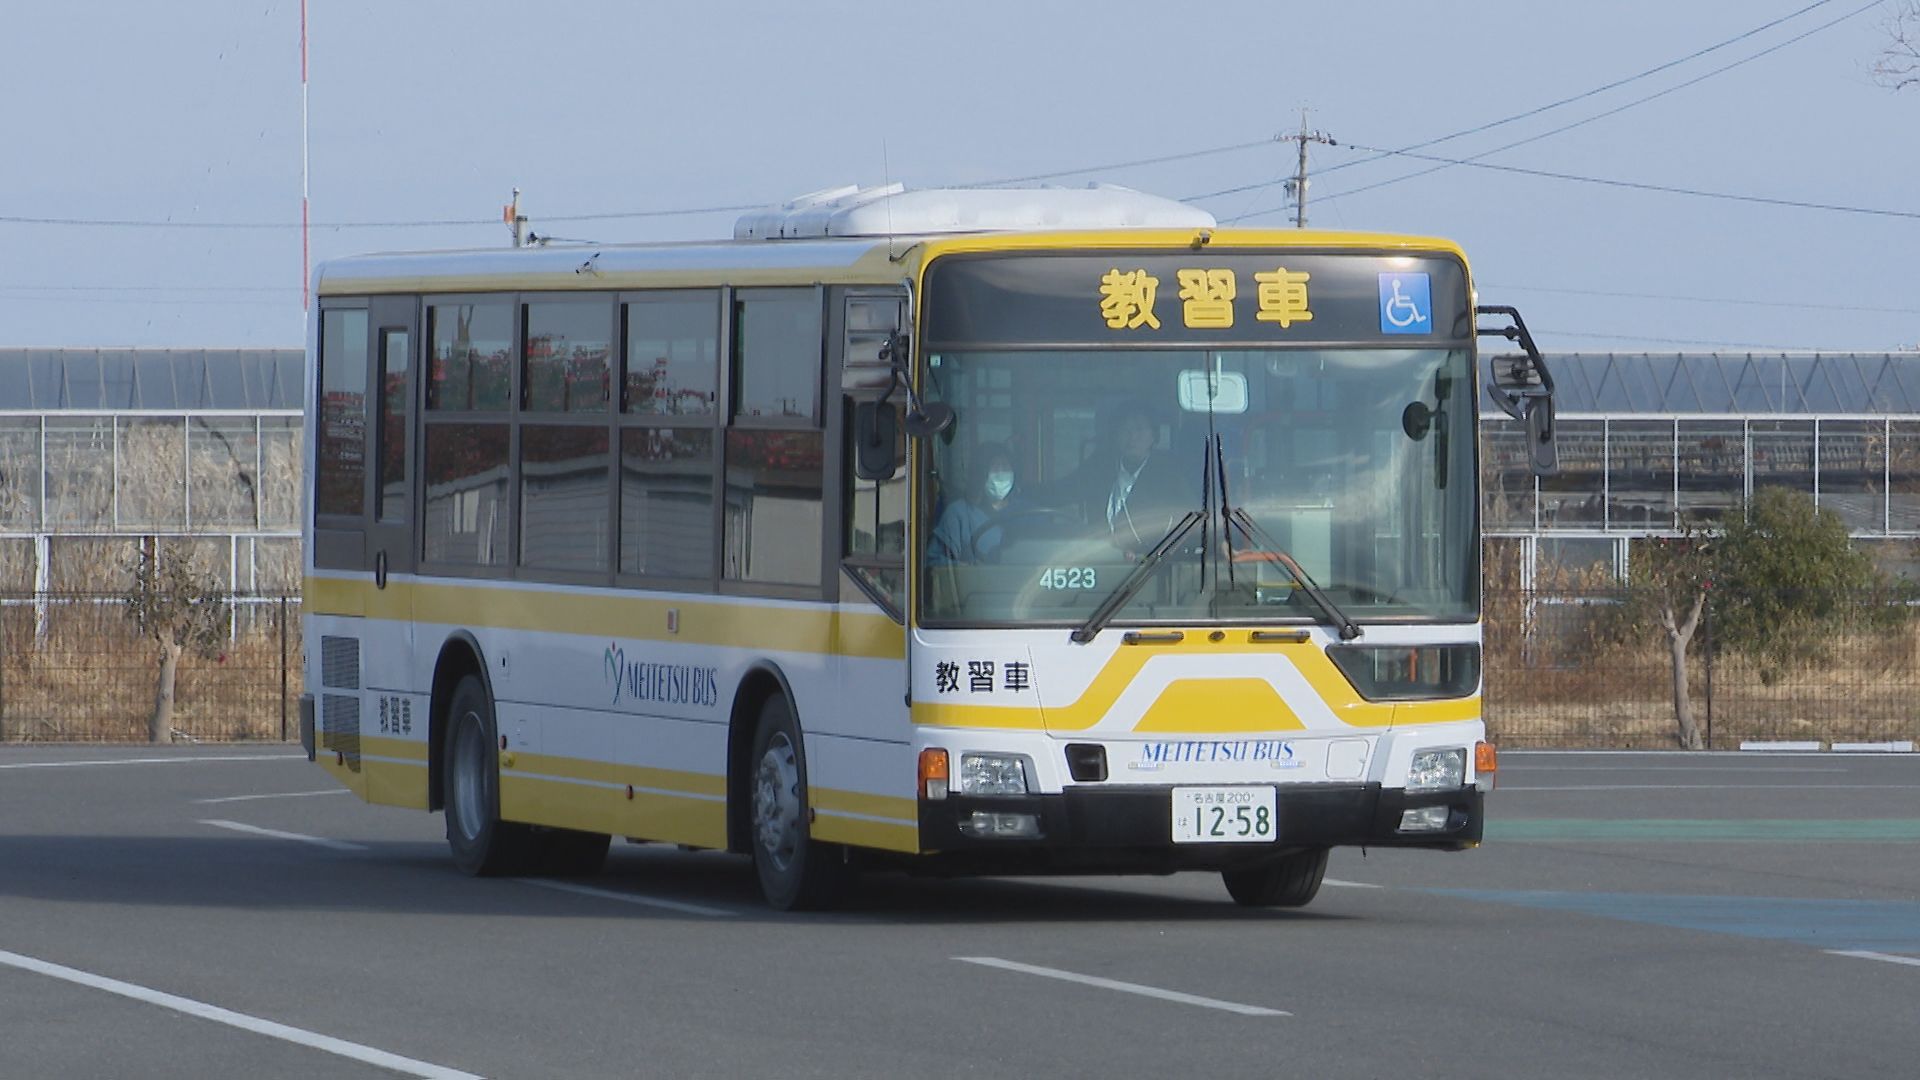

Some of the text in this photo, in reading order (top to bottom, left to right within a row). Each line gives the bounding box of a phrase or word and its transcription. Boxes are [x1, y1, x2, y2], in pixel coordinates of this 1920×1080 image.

[1100, 267, 1314, 330] 教習車
[1039, 567, 1096, 589] 4523
[627, 661, 718, 707] MEITETSU BUS
[935, 661, 1030, 694] 教習車
[1142, 740, 1294, 762] MEITETSU BUS
